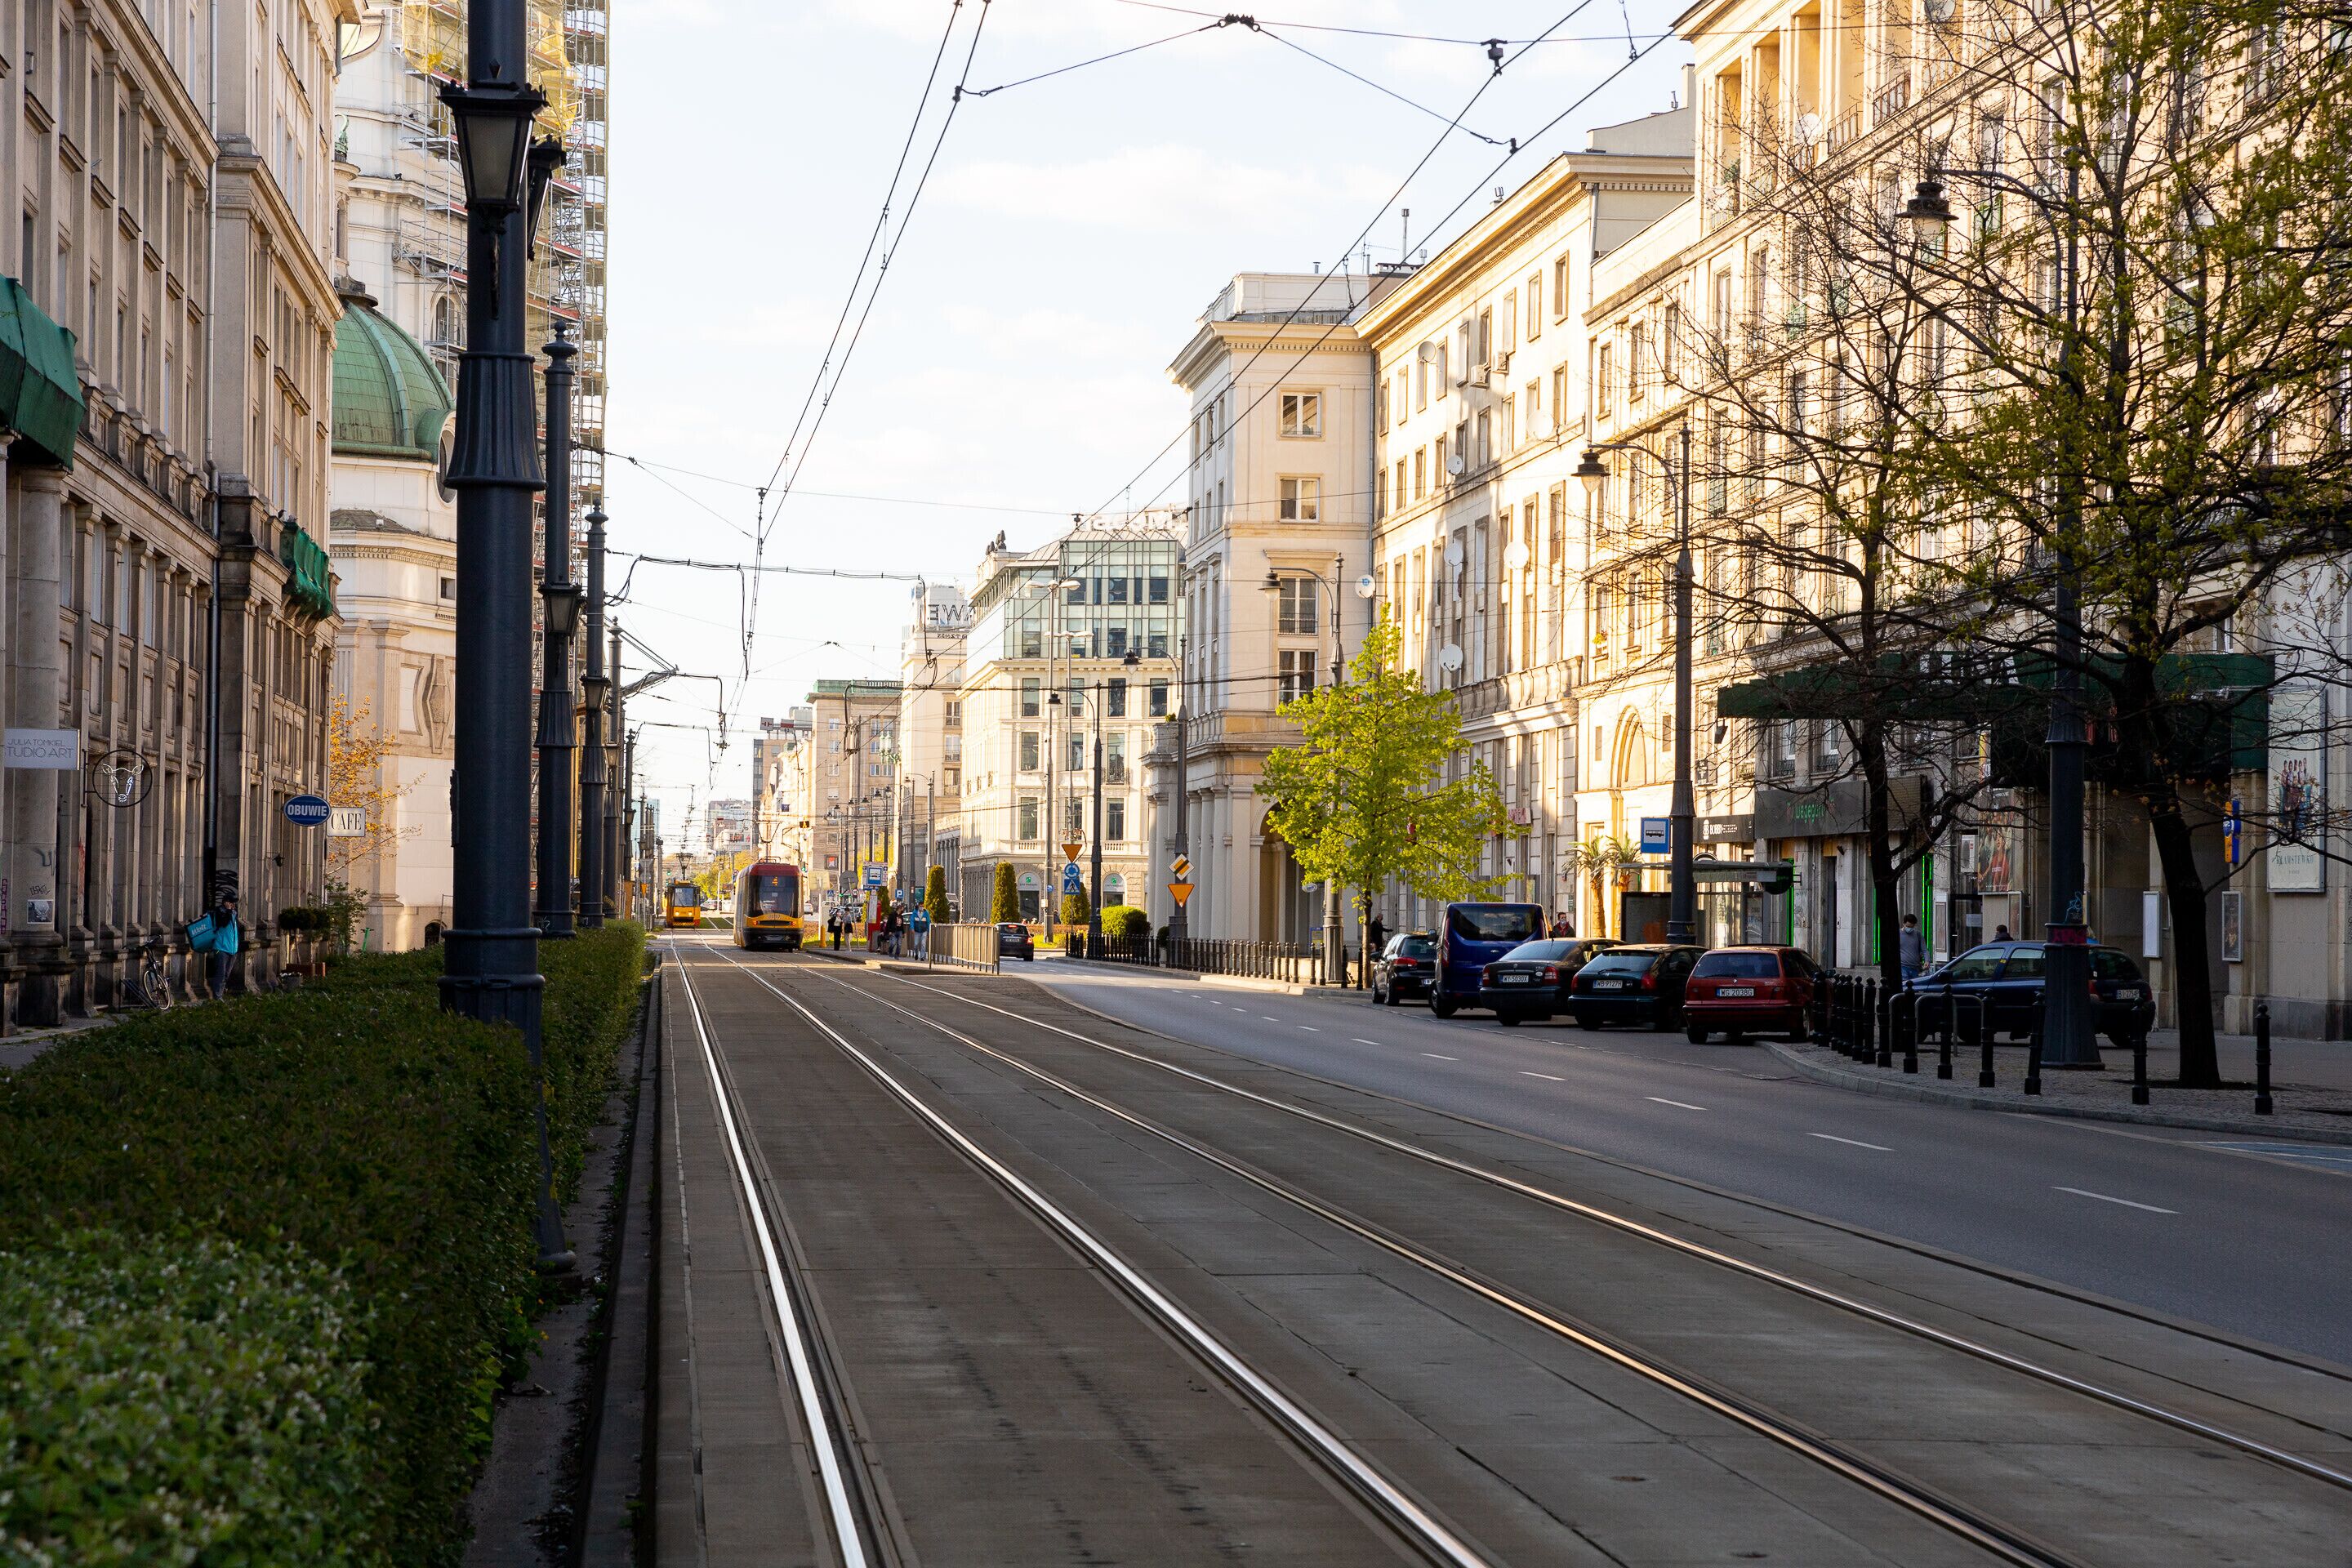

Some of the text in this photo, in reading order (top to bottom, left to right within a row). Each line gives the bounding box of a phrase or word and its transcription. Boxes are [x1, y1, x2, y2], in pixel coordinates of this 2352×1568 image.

[5, 746, 74, 759] TUDIO ART
[287, 804, 327, 817] OBUWIE
[330, 813, 362, 831] CAFE
[1710, 823, 1722, 835] BOBBY
[191, 924, 207, 936] Wolt
